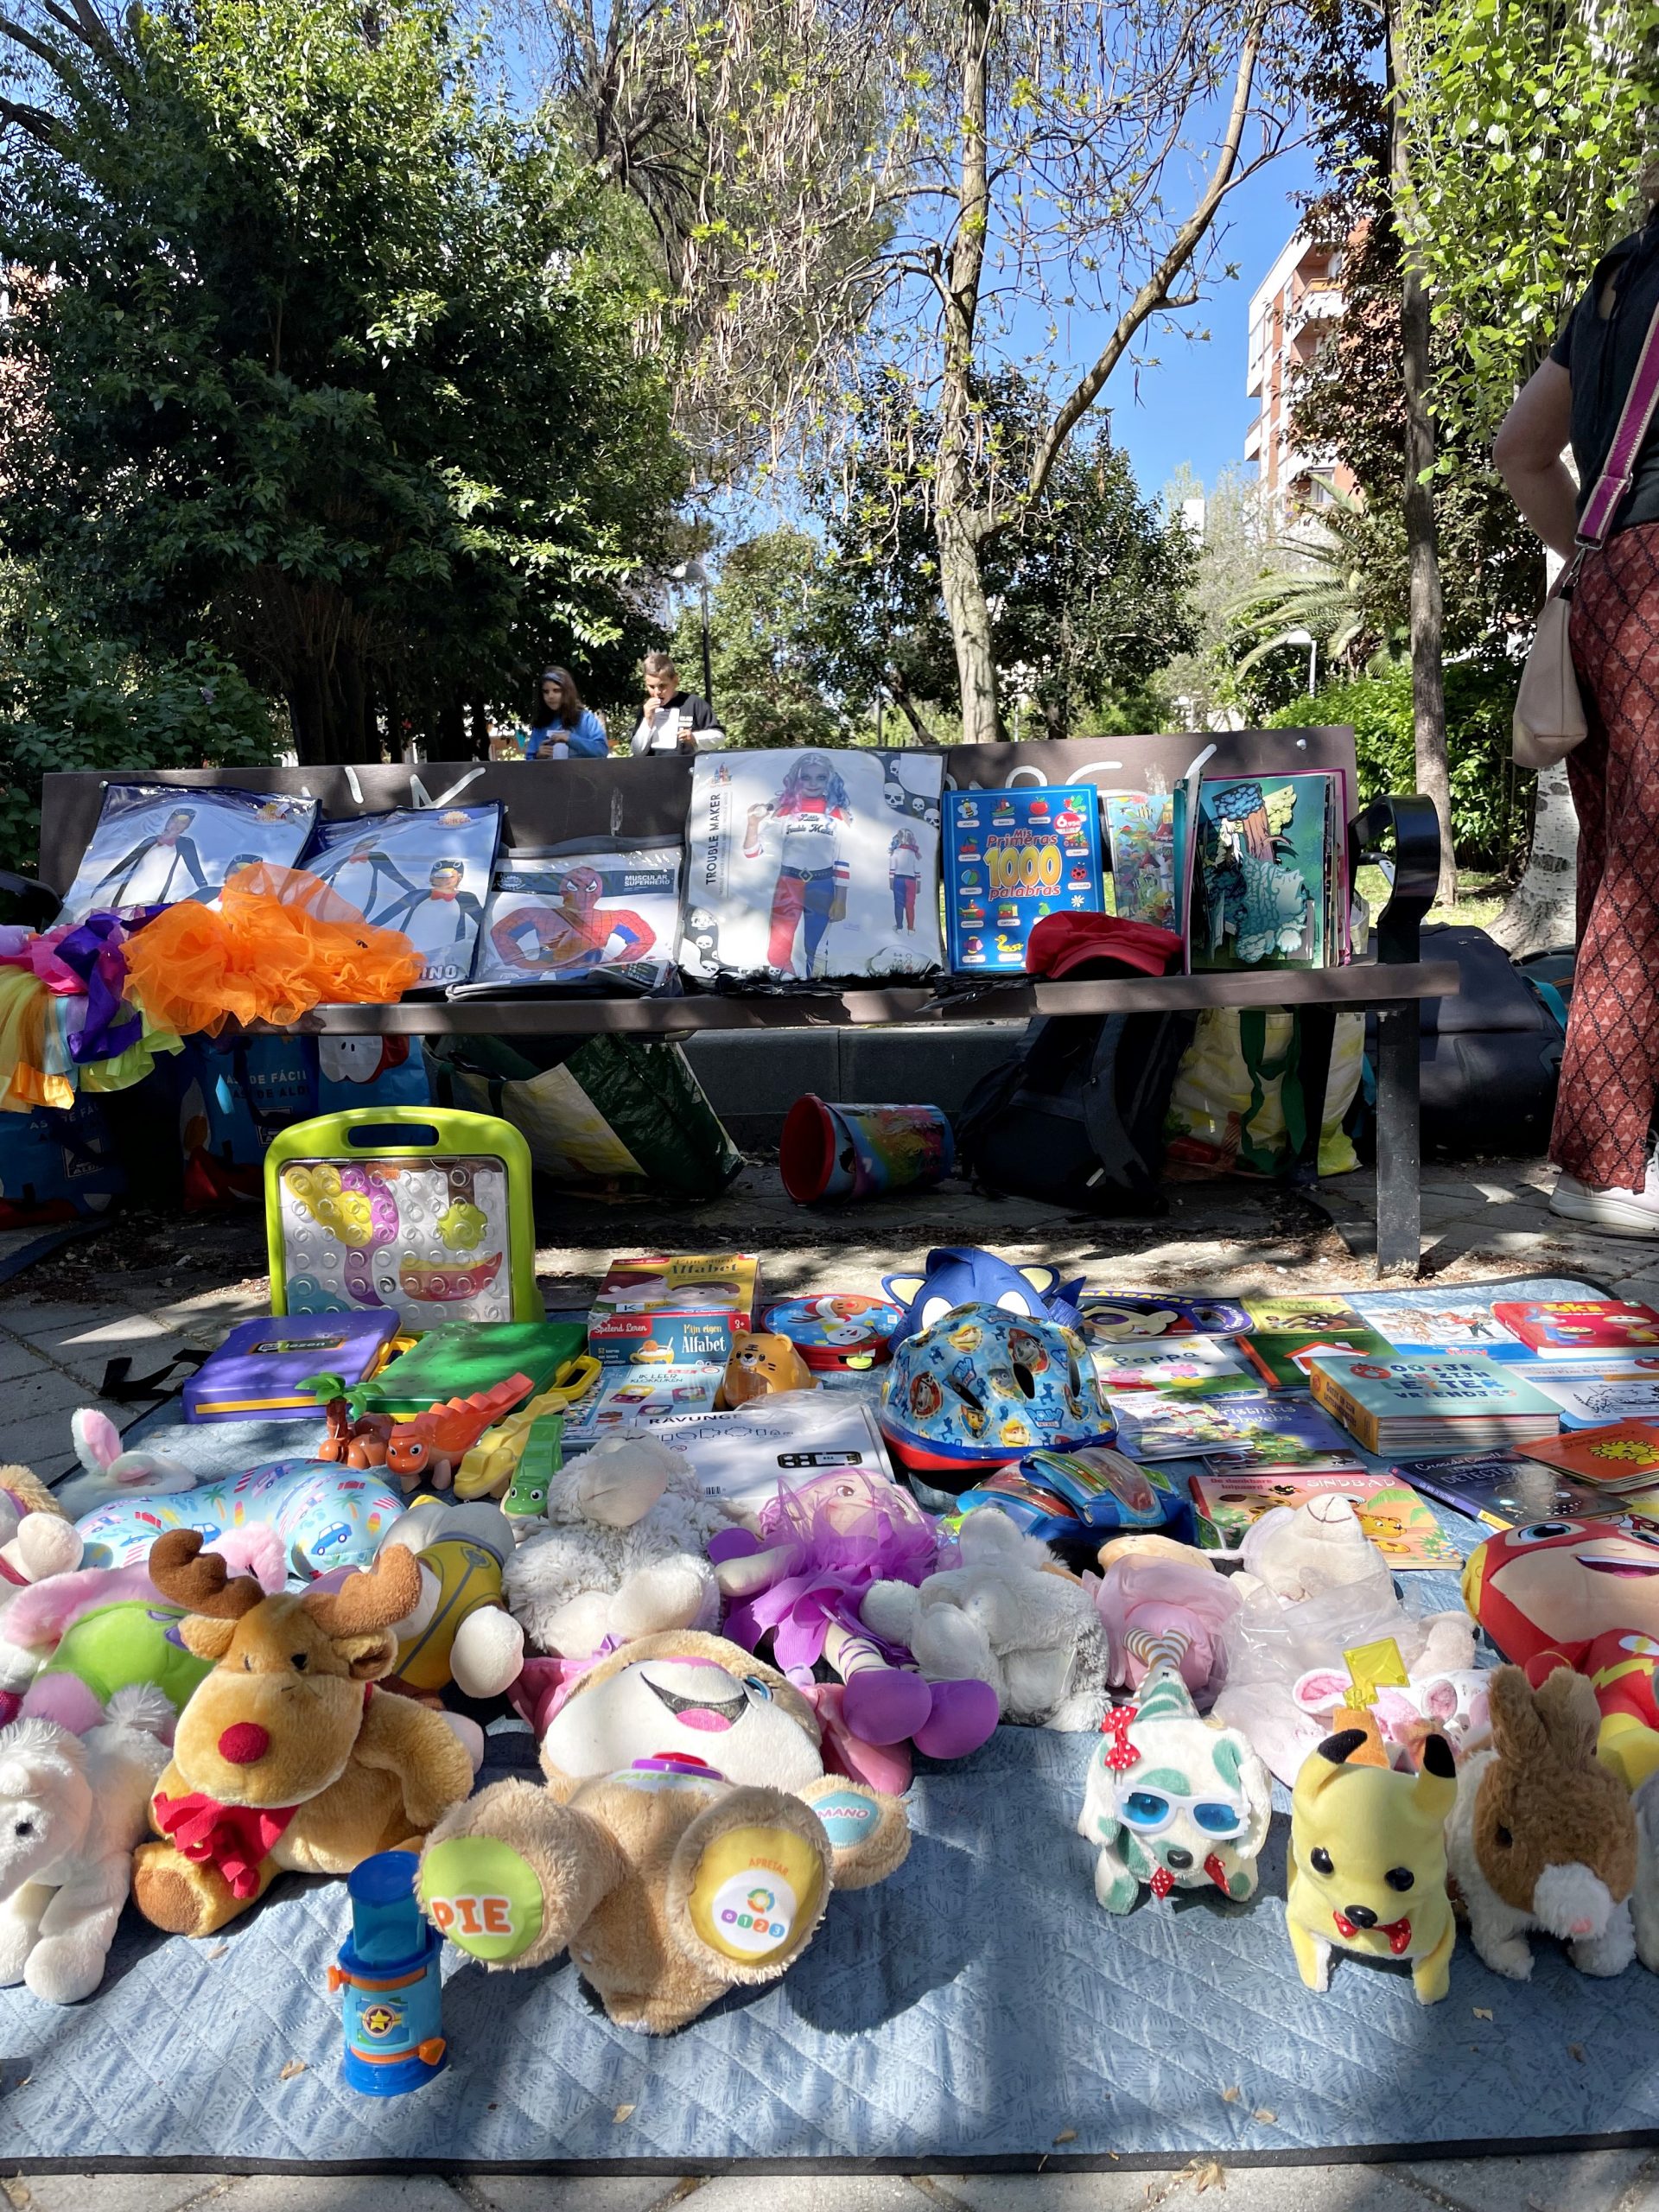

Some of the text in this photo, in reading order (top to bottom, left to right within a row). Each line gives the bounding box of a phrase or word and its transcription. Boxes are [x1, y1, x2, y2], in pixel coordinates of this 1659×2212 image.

[705, 793, 721, 886] TROUBLE MAKER
[1014, 829, 1033, 838] Mis
[987, 834, 1058, 849] Primeras
[983, 844, 1063, 888] 1000
[988, 884, 1061, 902] palabras
[249, 1074, 265, 1084] DE
[671, 1263, 739, 1274] Alfabet
[594, 1322, 647, 1335] Spelend Leren
[683, 1324, 722, 1335] Mijn eigen
[734, 1319, 745, 1329] 3+
[682, 1336, 727, 1353] Alfabet
[1113, 1352, 1200, 1366] Peppa
[1383, 1379, 1506, 1390] LETTER
[1394, 1390, 1517, 1399] VRIENDJES
[1221, 1405, 1296, 1415] ristmas
[1228, 1413, 1293, 1424] obwebs
[1414, 1459, 1465, 1471] Cressida
[1440, 1465, 1518, 1484] DETECTIV
[1306, 1478, 1396, 1488] SINDBAD
[817, 1808, 868, 1818] MANO
[748, 1858, 789, 1877] APRETAR
[431, 1897, 512, 1935] PIE
[756, 1921, 765, 1931] 2
[773, 1925, 782, 1936] 3
